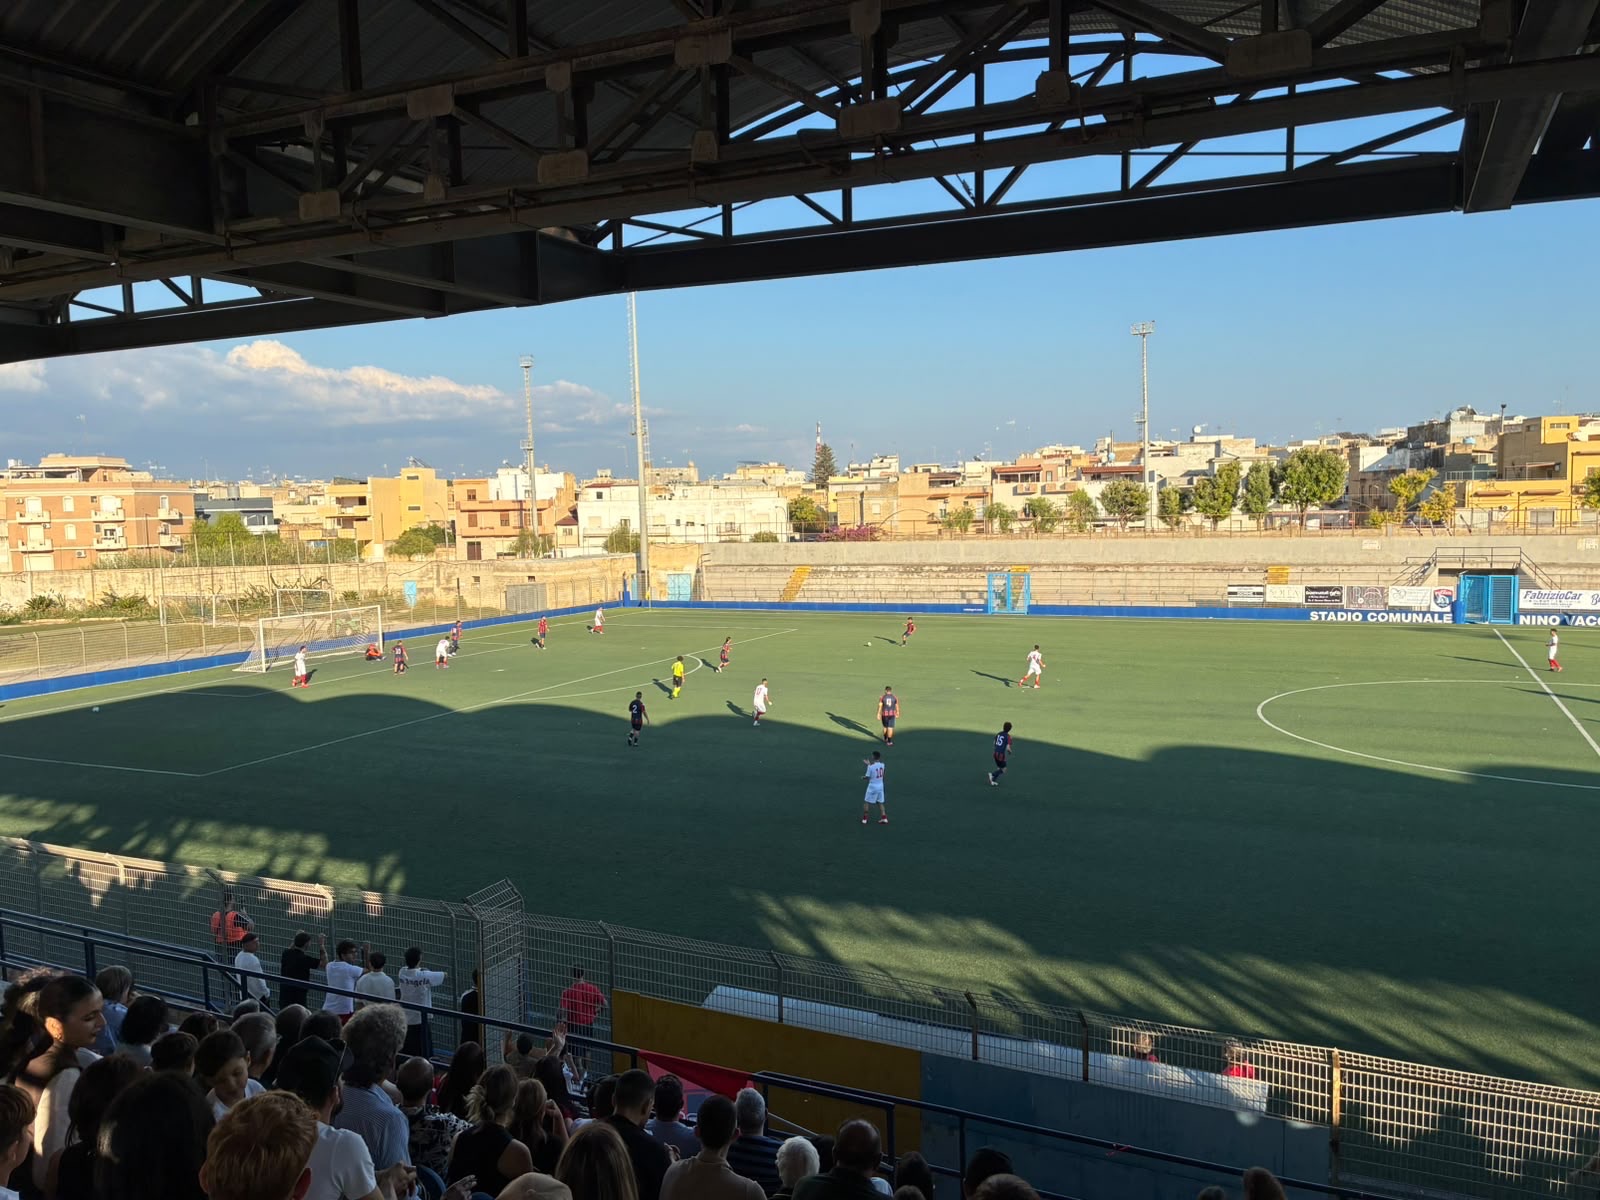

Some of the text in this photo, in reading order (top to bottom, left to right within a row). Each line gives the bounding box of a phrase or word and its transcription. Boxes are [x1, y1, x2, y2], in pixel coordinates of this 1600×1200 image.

[1523, 590, 1583, 600] FabrizioCar
[1310, 611, 1453, 623] STADIO COMUNALE
[1520, 615, 1600, 627] NINO VAC
[632, 704, 638, 714] 2
[995, 734, 1005, 746] 15
[875, 767, 884, 779] 10
